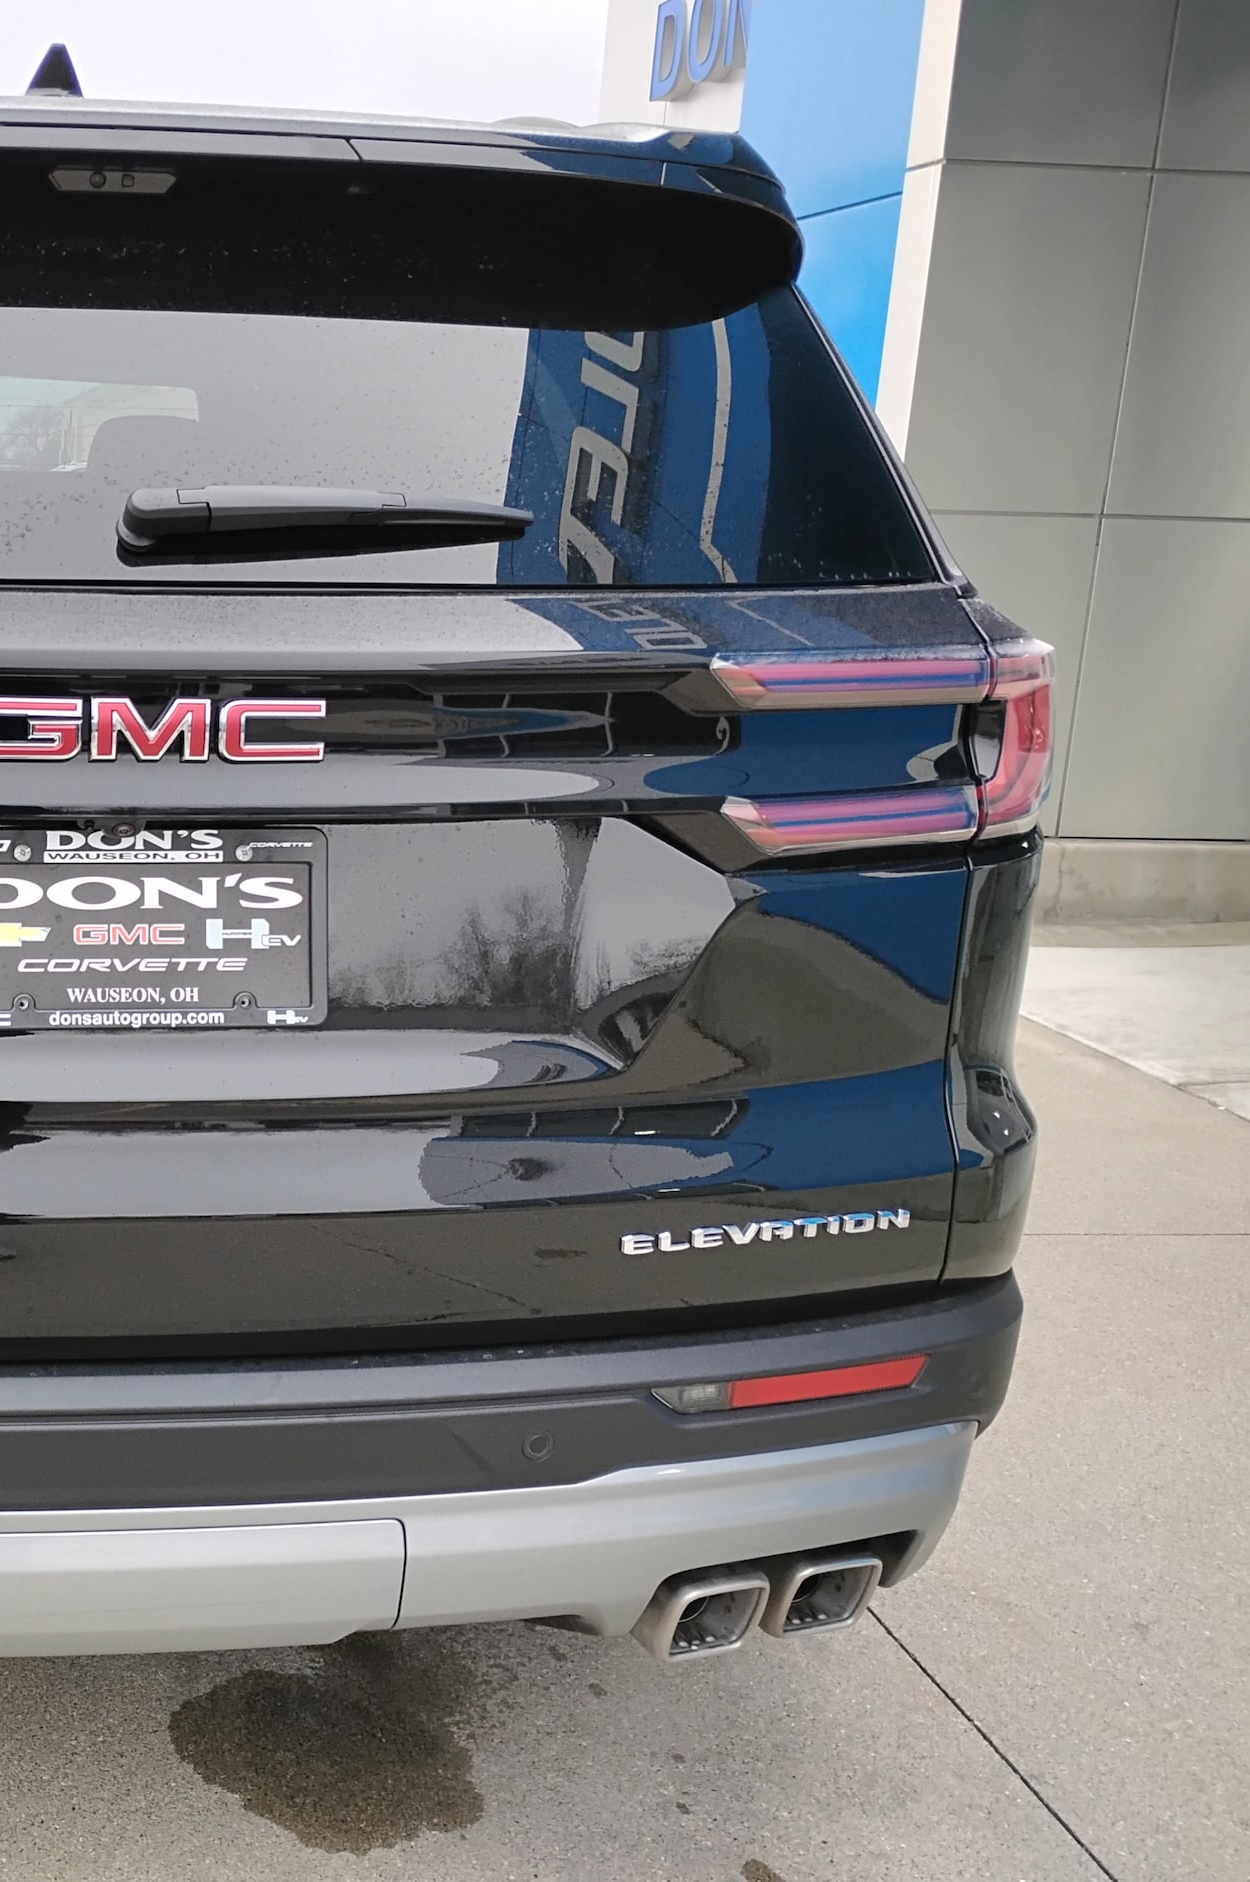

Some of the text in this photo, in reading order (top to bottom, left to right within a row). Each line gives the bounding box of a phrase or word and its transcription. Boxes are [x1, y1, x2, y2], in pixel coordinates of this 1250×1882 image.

[46, 829, 224, 850] DON'S
[49, 852, 221, 861] WAUSEON, OH
[73, 923, 185, 945] GMC
[17, 957, 248, 973] CORVETTE
[67, 987, 200, 1005] WAUSEON, OH
[49, 1010, 225, 1028] donsautogroup.com
[620, 1207, 911, 1256] ELEVATION
